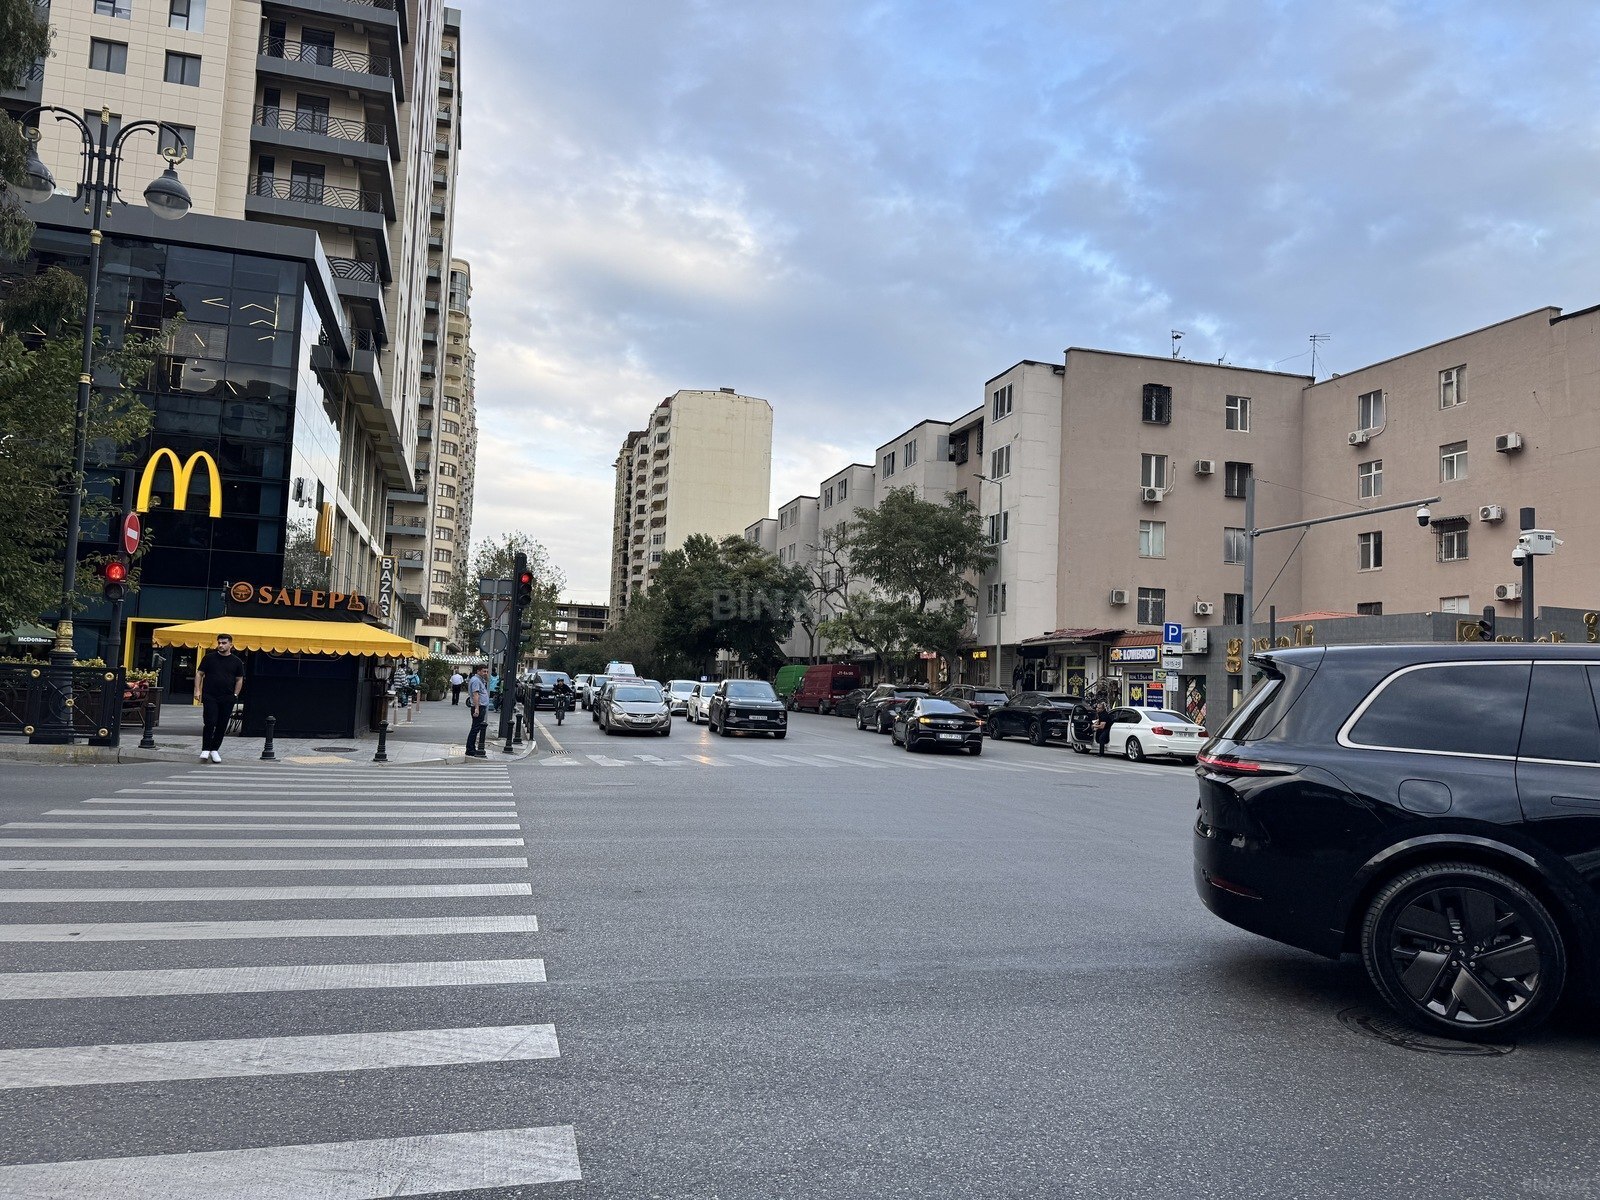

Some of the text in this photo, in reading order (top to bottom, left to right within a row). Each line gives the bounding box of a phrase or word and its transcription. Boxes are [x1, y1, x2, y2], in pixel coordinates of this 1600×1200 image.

[379, 558, 392, 616] BAZAR
[258, 585, 345, 610] SALEP
[1168, 625, 1179, 641] P
[1122, 648, 1156, 660] LOMBARD
